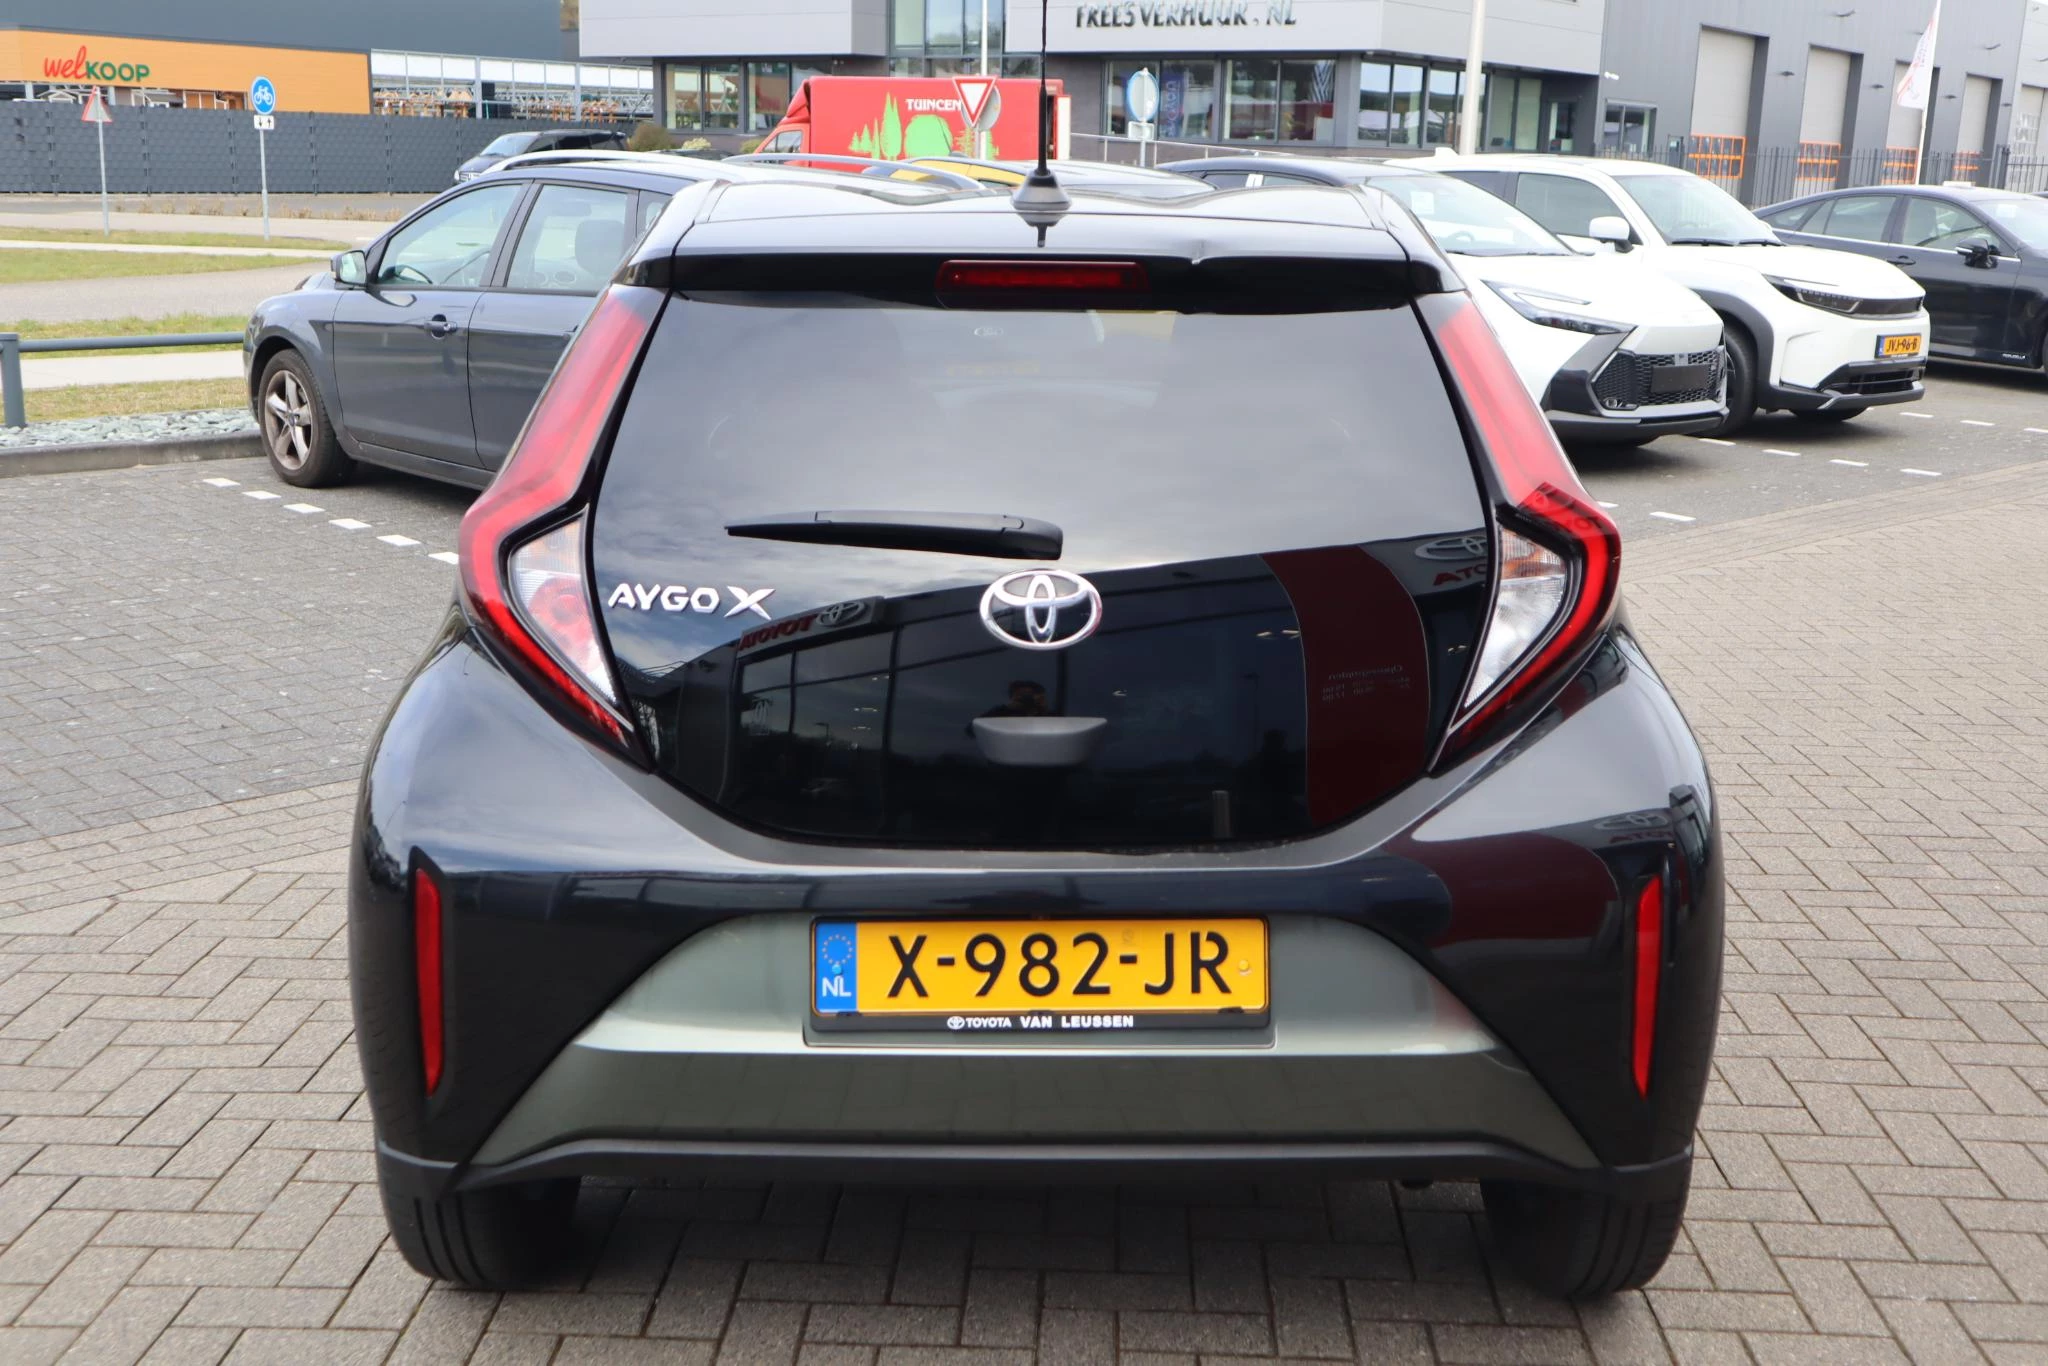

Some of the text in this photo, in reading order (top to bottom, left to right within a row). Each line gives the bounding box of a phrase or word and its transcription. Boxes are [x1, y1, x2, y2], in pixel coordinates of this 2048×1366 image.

[607, 582, 776, 621] AYGO X
[886, 931, 1232, 998] X-982-JR
[822, 976, 852, 997] NL
[965, 1015, 1134, 1029] TOYOTA VAN LEUSSEN
